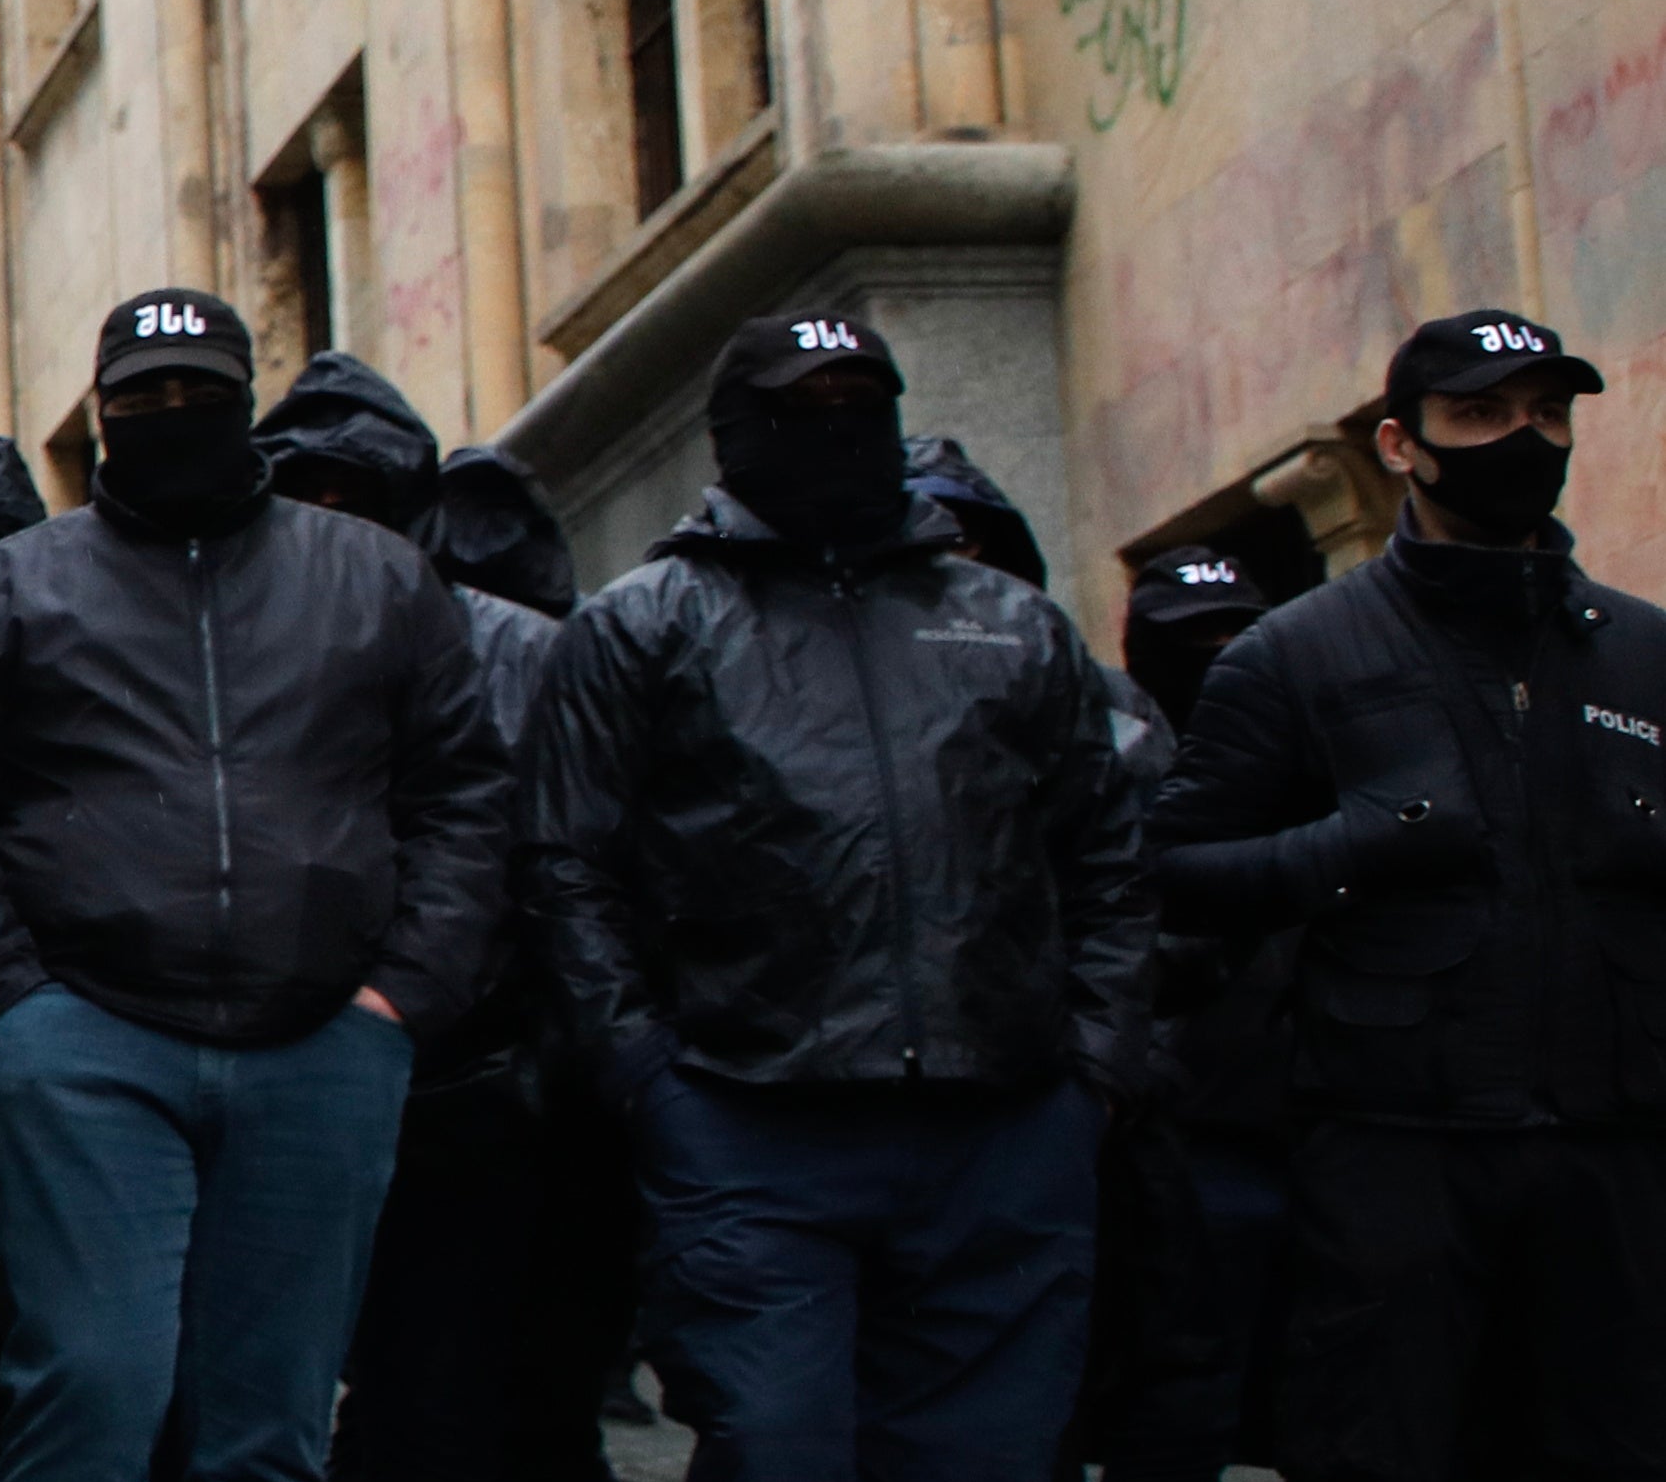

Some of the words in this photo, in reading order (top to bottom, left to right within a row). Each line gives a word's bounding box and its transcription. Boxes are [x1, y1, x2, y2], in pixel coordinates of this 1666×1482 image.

[133, 302, 206, 338] შსს
[789, 319, 859, 351] შსს
[1469, 322, 1544, 353] შსს
[1583, 703, 1662, 747] POLICE
